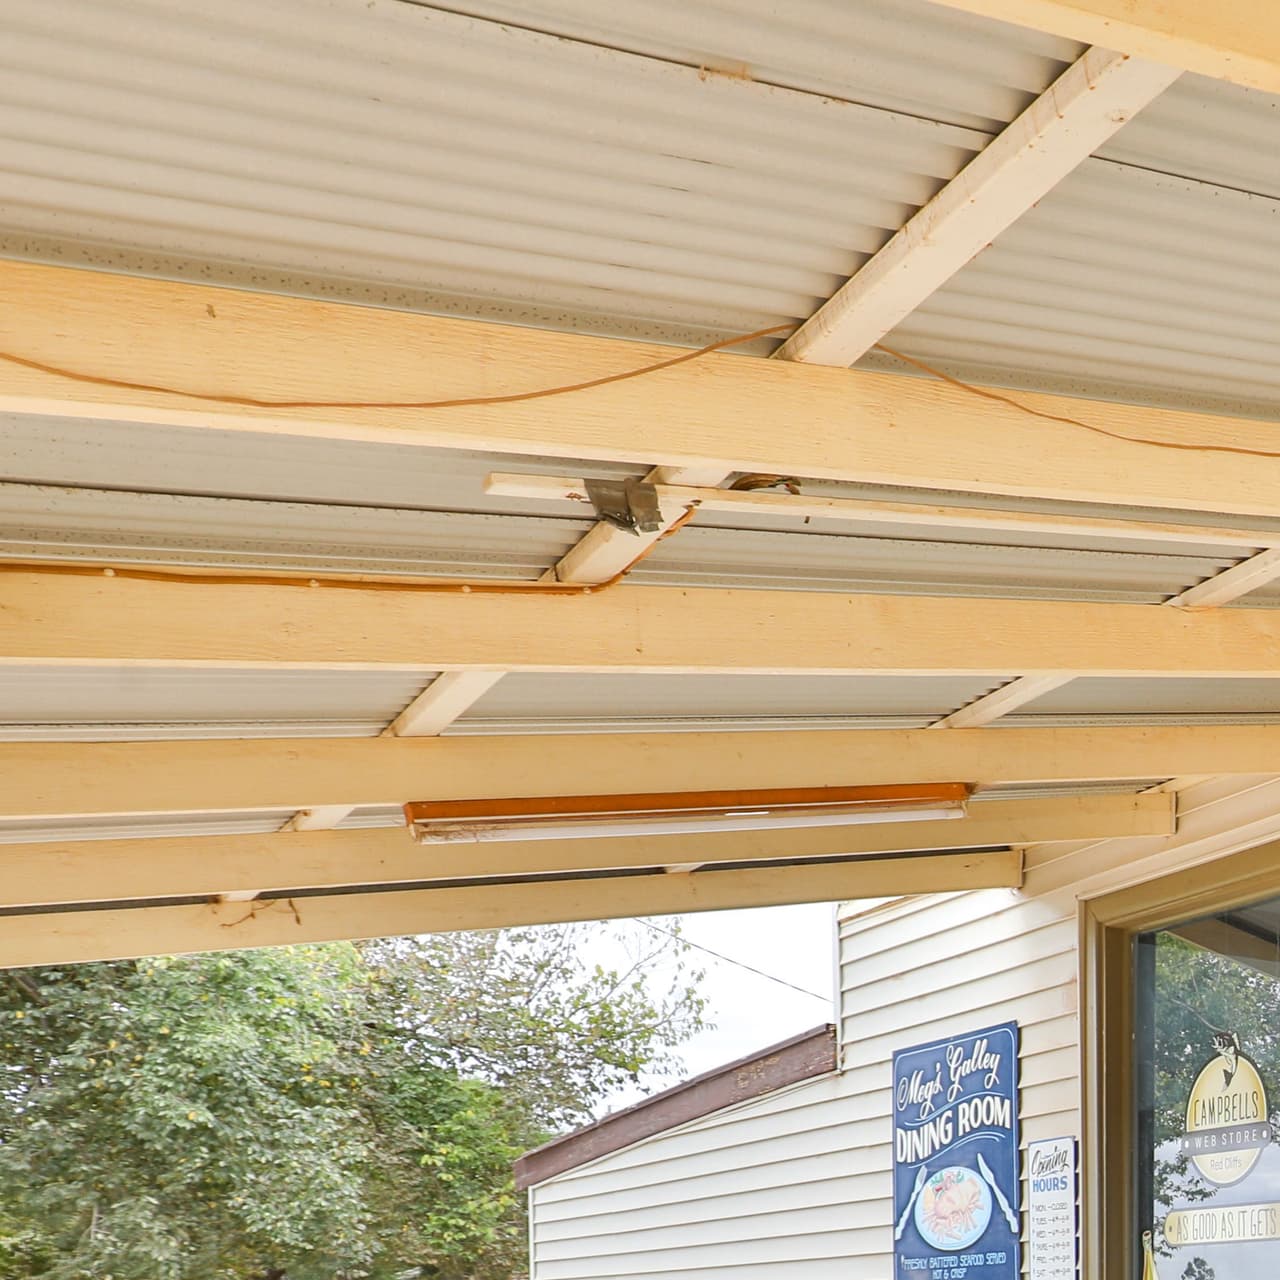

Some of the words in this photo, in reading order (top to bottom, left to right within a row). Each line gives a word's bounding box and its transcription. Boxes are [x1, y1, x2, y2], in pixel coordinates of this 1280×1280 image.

[946, 1039, 1001, 1102] Galley
[1193, 1090, 1260, 1127] CAMPBELLS
[896, 1110, 953, 1163] DINING
[958, 1096, 1011, 1136] ROOM
[1194, 1134, 1217, 1150] WEB
[1222, 1129, 1258, 1146] STORE
[1033, 1176, 1068, 1192] HOURS
[1176, 1216, 1189, 1242] AS
[1192, 1211, 1217, 1240] GOOD
[1221, 1209, 1235, 1239] AS
[1238, 1208, 1248, 1238] IT
[1250, 1206, 1277, 1238] GETS
